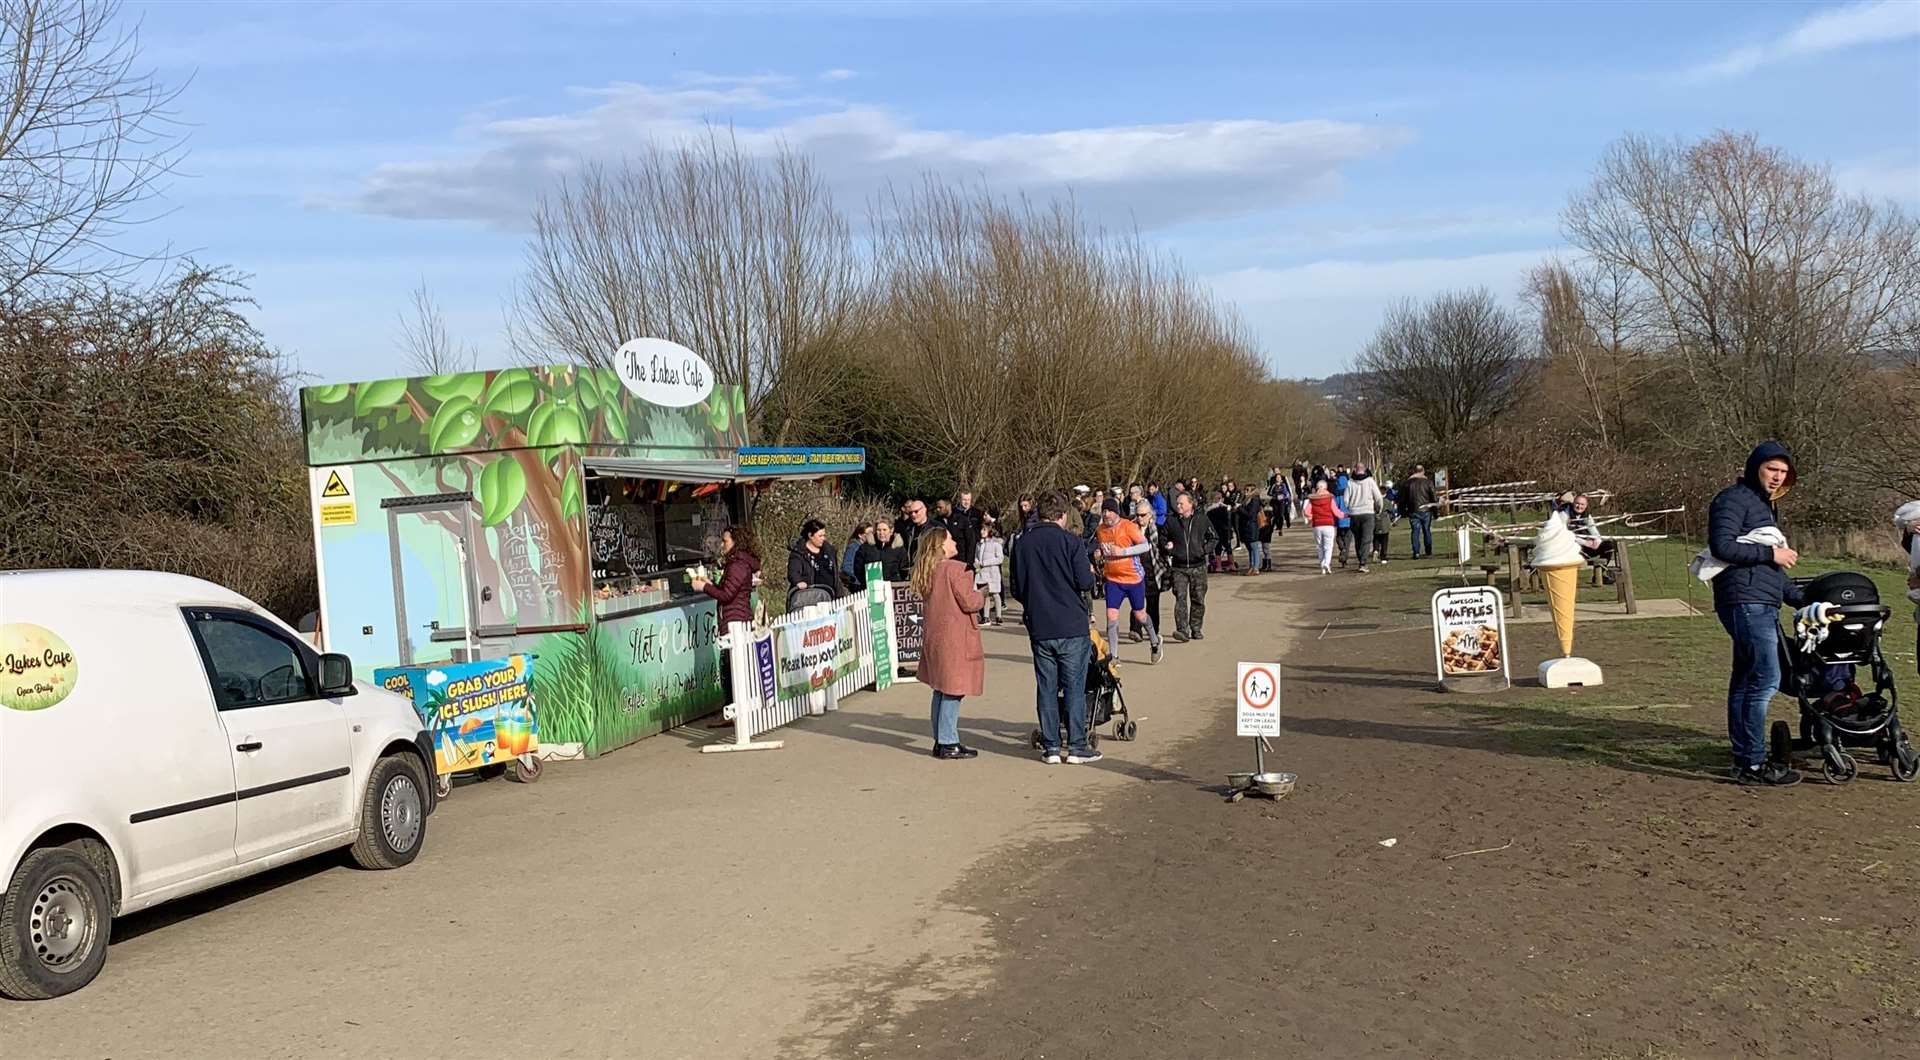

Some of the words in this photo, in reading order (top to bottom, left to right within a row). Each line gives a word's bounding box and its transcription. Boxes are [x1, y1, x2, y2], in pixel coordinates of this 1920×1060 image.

[624, 350, 646, 381] The
[650, 354, 680, 384] Lakes
[682, 360, 705, 392] Cafe
[739, 454, 758, 465] PLEASE
[758, 454, 770, 465] KEEP
[770, 454, 792, 464] FOOTPATH
[792, 453, 806, 464] CLEAR
[892, 588, 924, 602] LEAS
[896, 615, 908, 626] AY
[1441, 604, 1494, 620] WAFFLES
[629, 624, 657, 665] Hot
[673, 612, 700, 655] Cld
[703, 611, 720, 646] Fo
[897, 626, 910, 637] EP
[5, 653, 42, 675] Lakes
[43, 648, 72, 668] Cafe
[781, 656, 801, 674] Please
[801, 652, 818, 669] Keep
[839, 637, 853, 654] Clear
[16, 686, 34, 697] Open
[34, 683, 54, 694] Daily
[385, 674, 409, 690] COOL
[448, 677, 482, 699] GRAB
[484, 668, 516, 689] YOUR
[439, 702, 460, 719] ICE
[462, 692, 497, 714] SLUSH
[499, 684, 528, 702] HERE
[620, 684, 646, 714] Coffee
